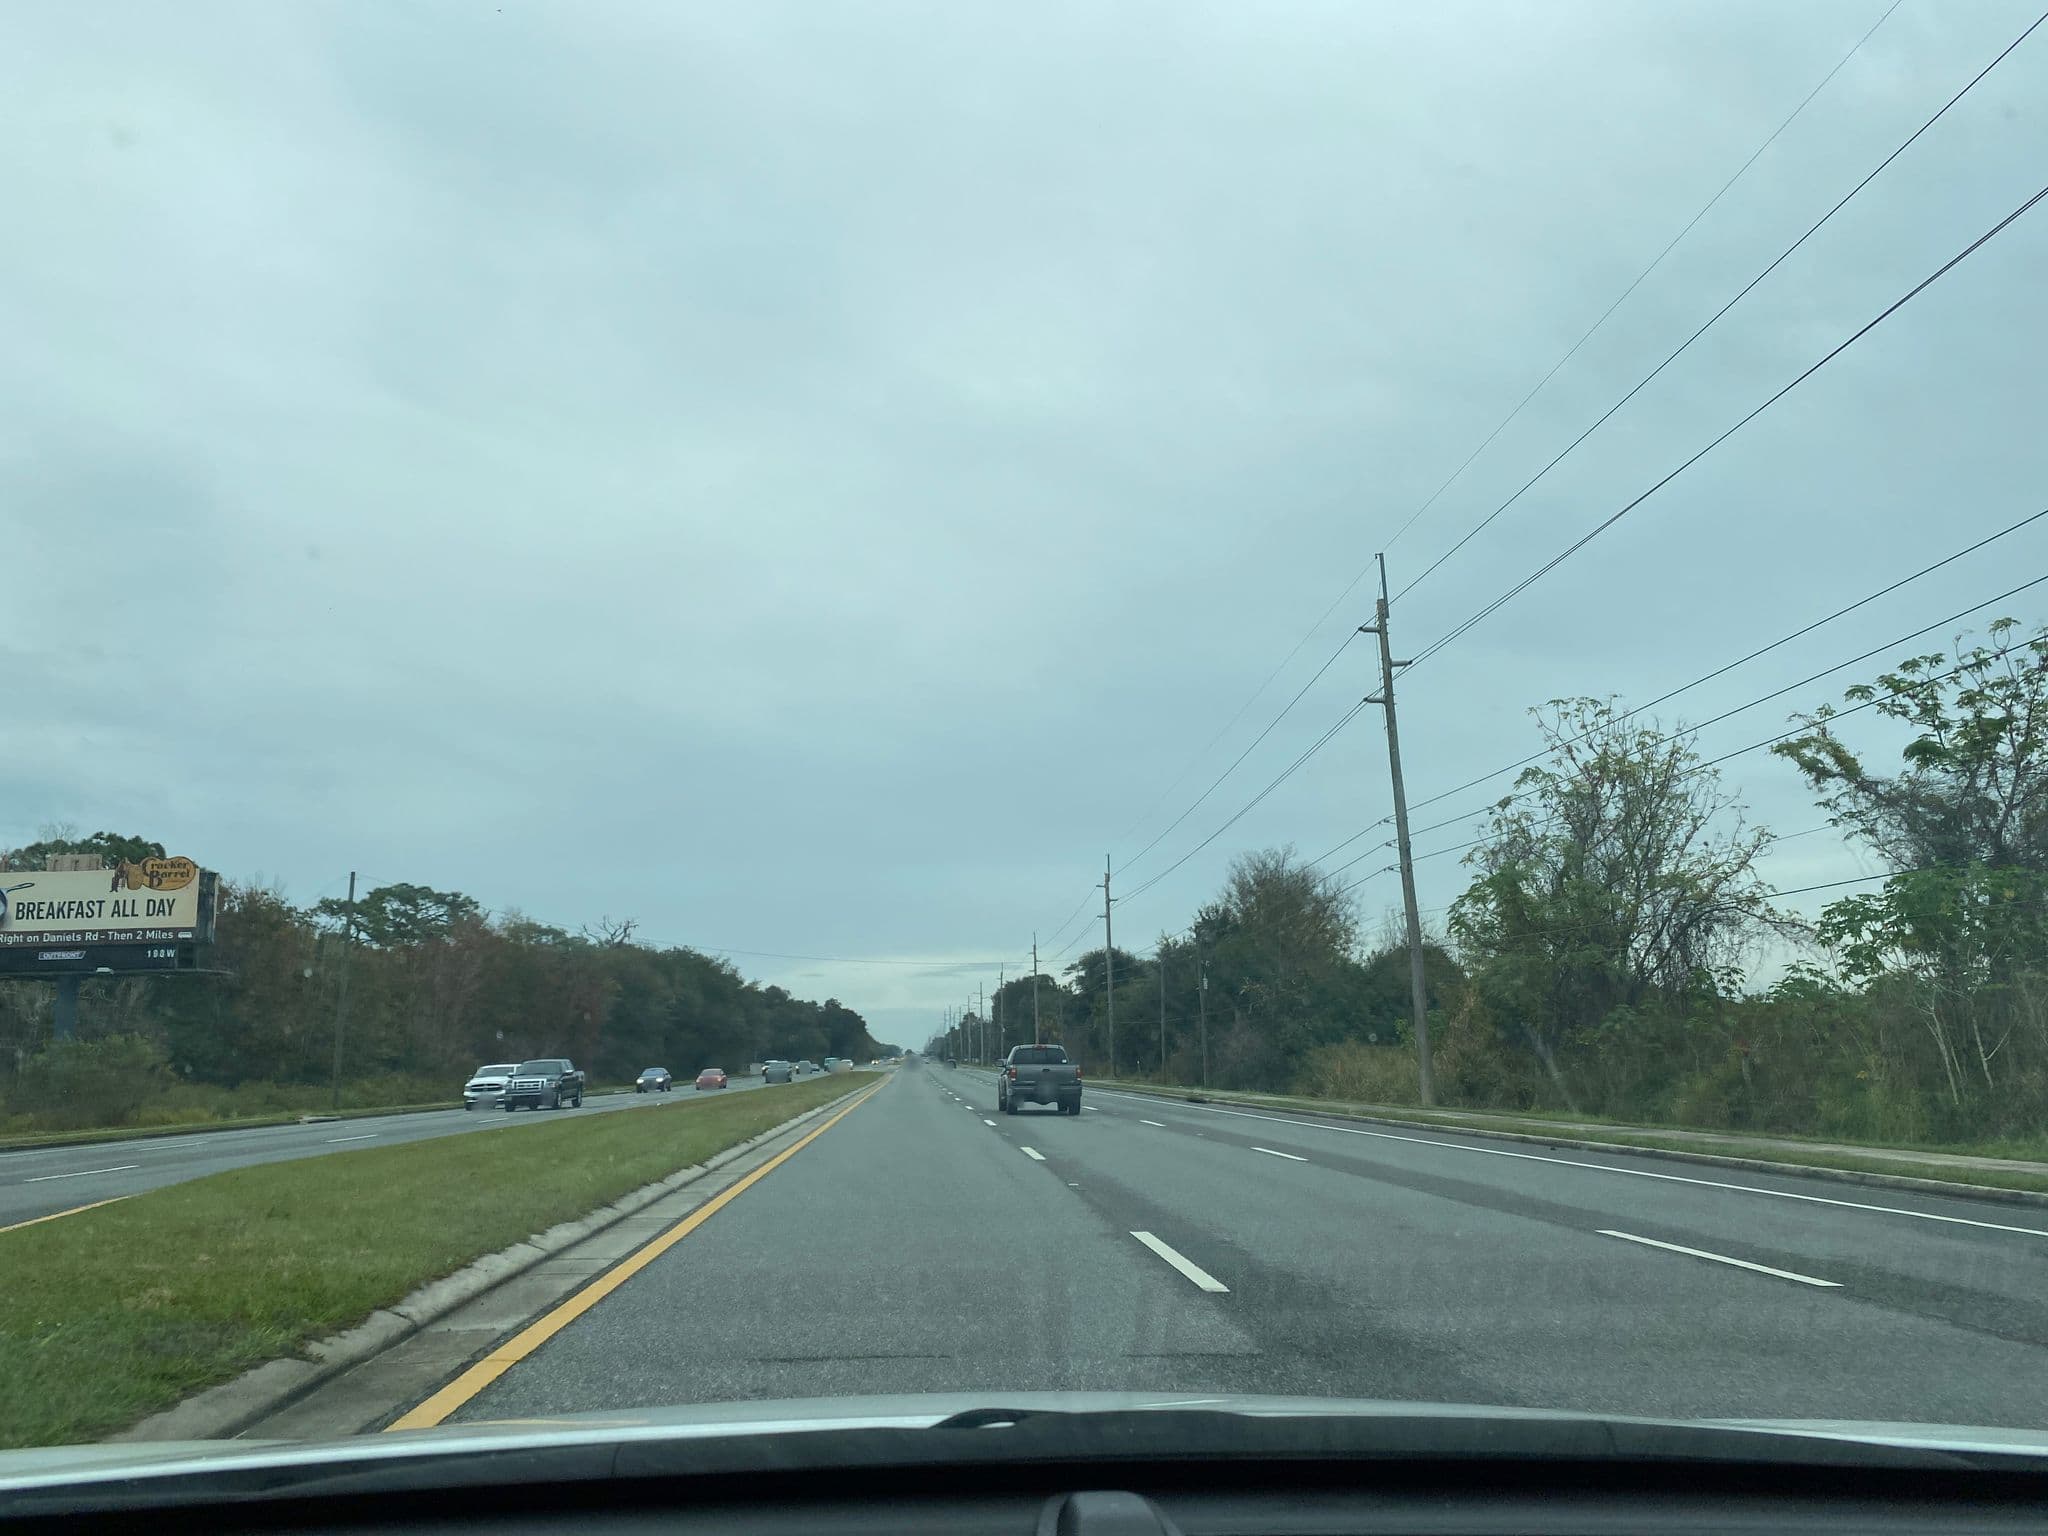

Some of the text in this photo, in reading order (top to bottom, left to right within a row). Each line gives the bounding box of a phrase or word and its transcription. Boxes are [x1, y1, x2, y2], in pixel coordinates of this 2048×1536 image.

[141, 857, 188, 877] Cracker
[149, 869, 190, 888] Barrel
[15, 898, 176, 920] BREAKFAST ALL DAY
[43, 932, 81, 942] Daniels
[85, 932, 99, 941] Rd
[108, 931, 133, 940] Then
[136, 931, 143, 940] 2
[146, 930, 174, 940] Miles
